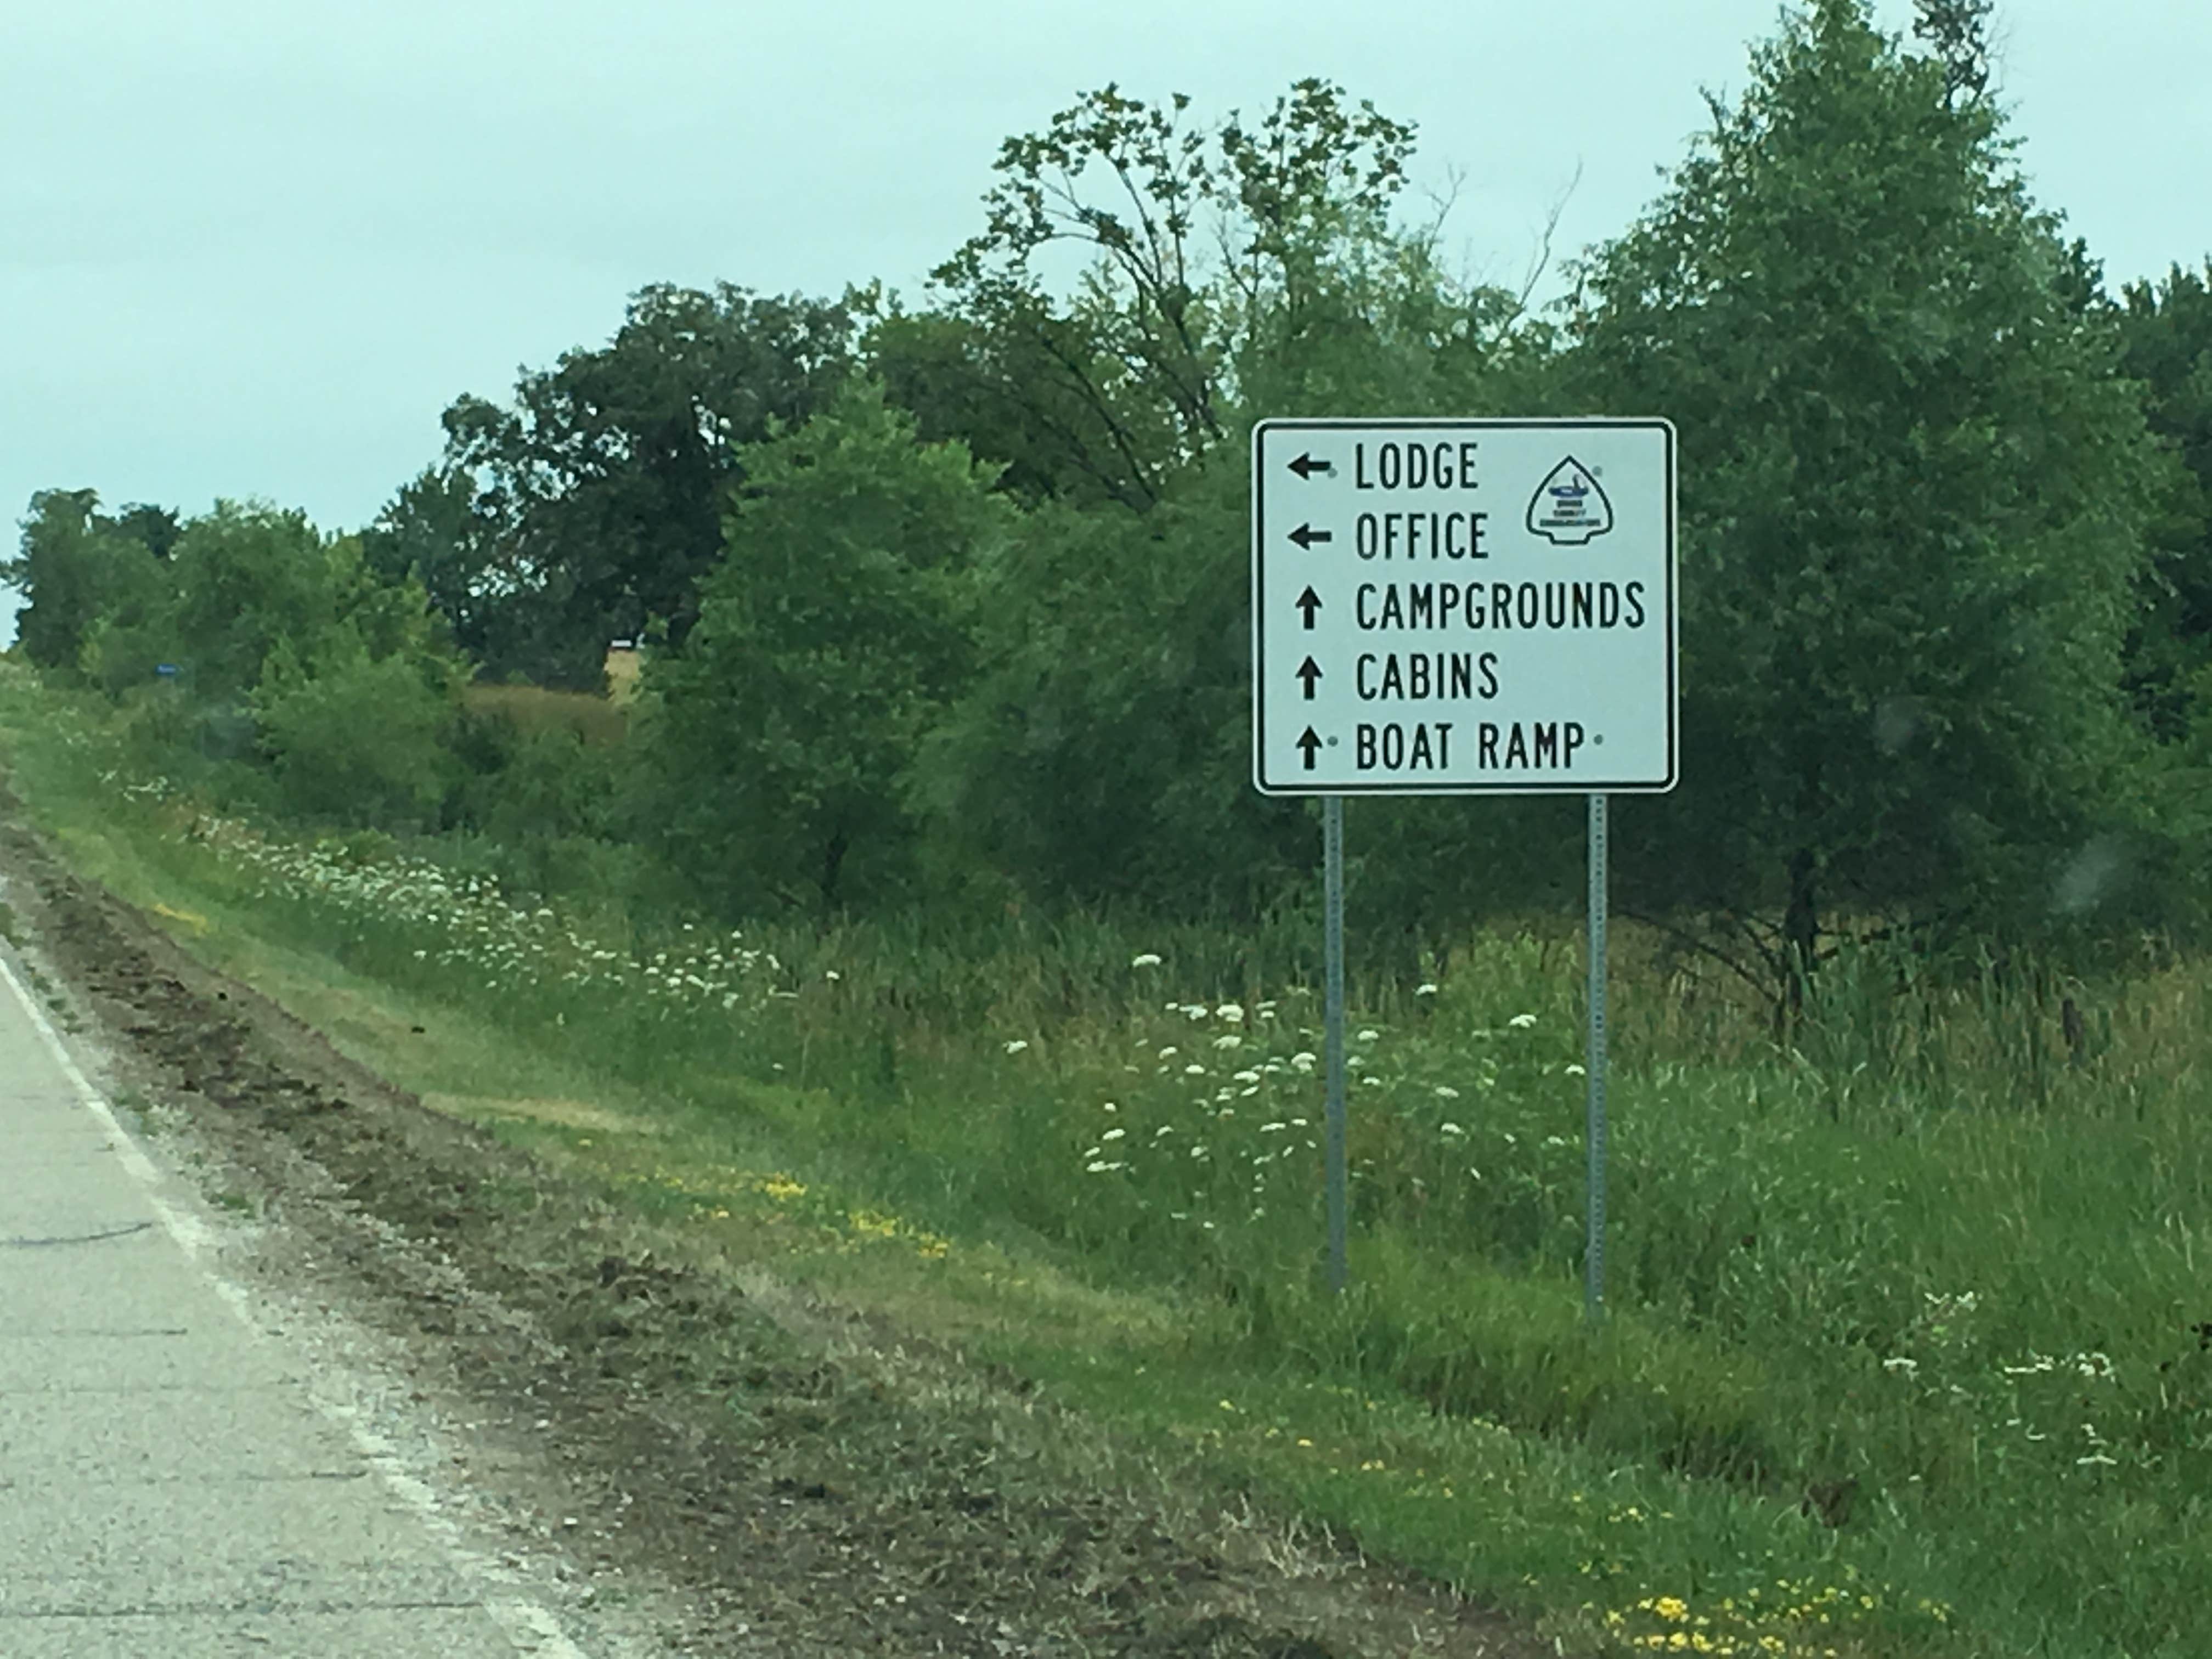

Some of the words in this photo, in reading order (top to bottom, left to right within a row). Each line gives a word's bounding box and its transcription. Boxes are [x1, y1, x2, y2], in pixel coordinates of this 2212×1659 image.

[1356, 443, 1478, 489] LODGE
[1357, 512, 1488, 560] OFFICE
[1357, 582, 1644, 630] CAMPGROUNDS
[1357, 652, 1498, 700] CABINS
[1357, 723, 1452, 770] BOAT
[1480, 723, 1583, 769] RAMP
